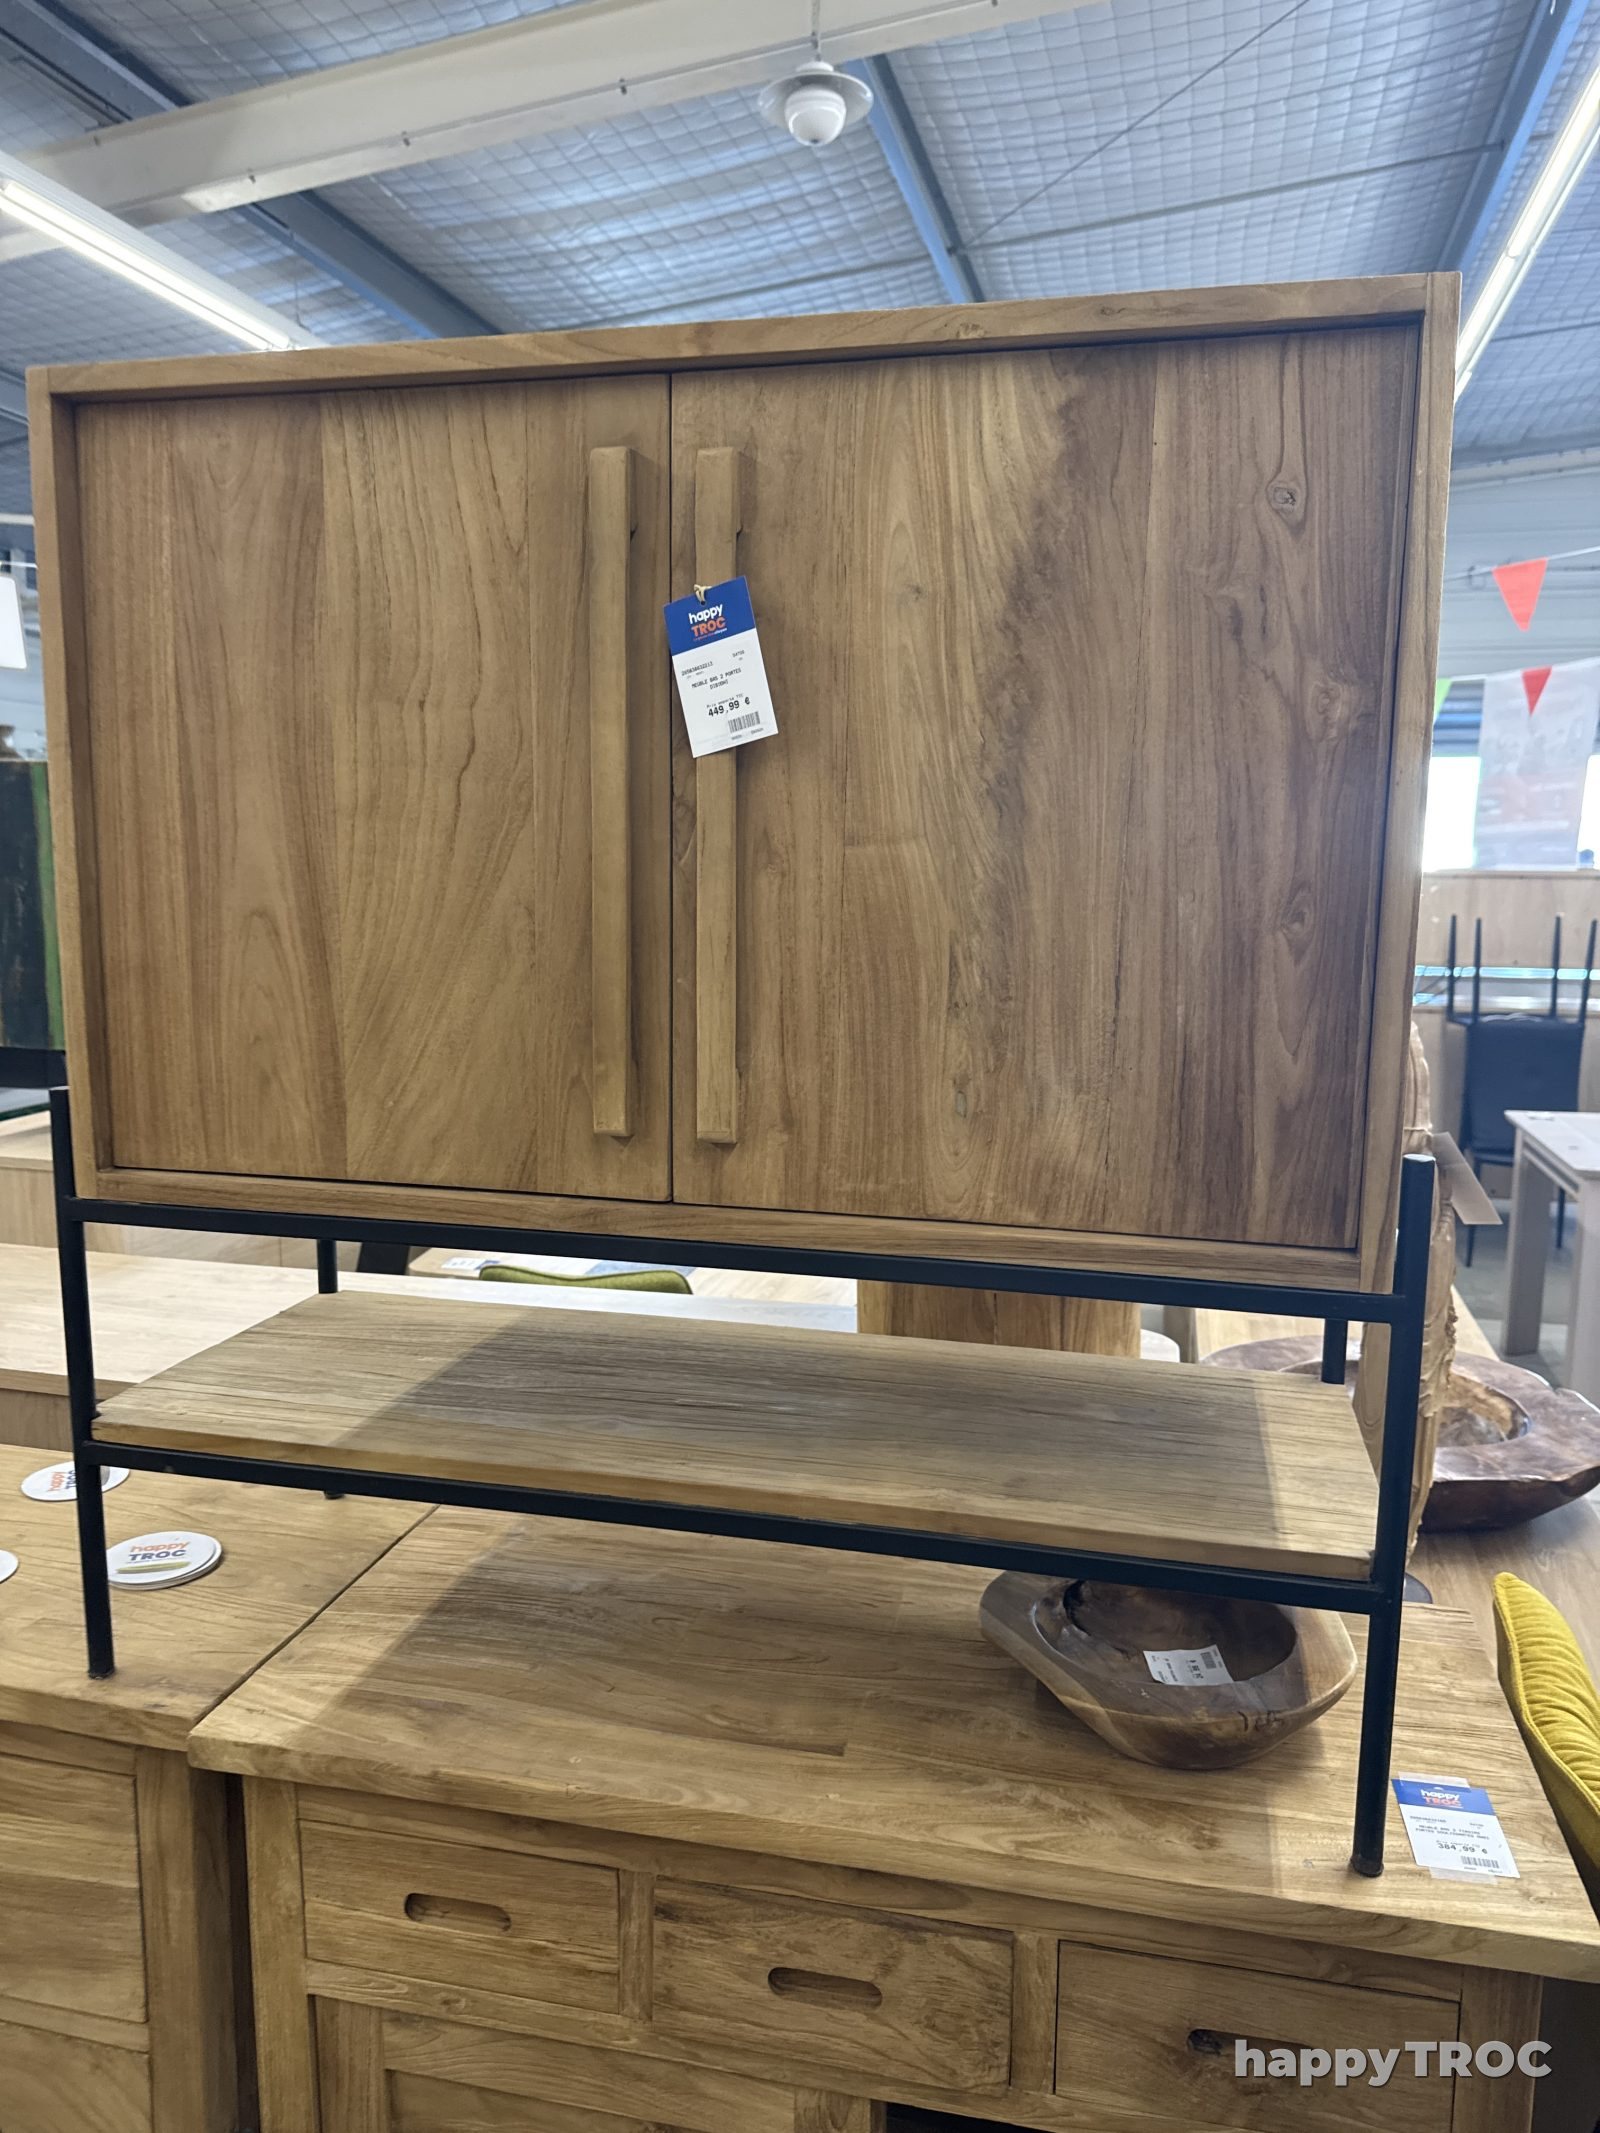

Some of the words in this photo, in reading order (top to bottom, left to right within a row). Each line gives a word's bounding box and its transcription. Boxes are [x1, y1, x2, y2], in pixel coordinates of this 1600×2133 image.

[688, 604, 723, 624] happy
[691, 616, 726, 637] TROC
[725, 667, 742, 677] PORTES
[708, 700, 740, 717] 449,99
[744, 696, 751, 705] €
[130, 1541, 190, 1553] happy
[128, 1549, 187, 1561] TROC
[1420, 1789, 1460, 1801] happy
